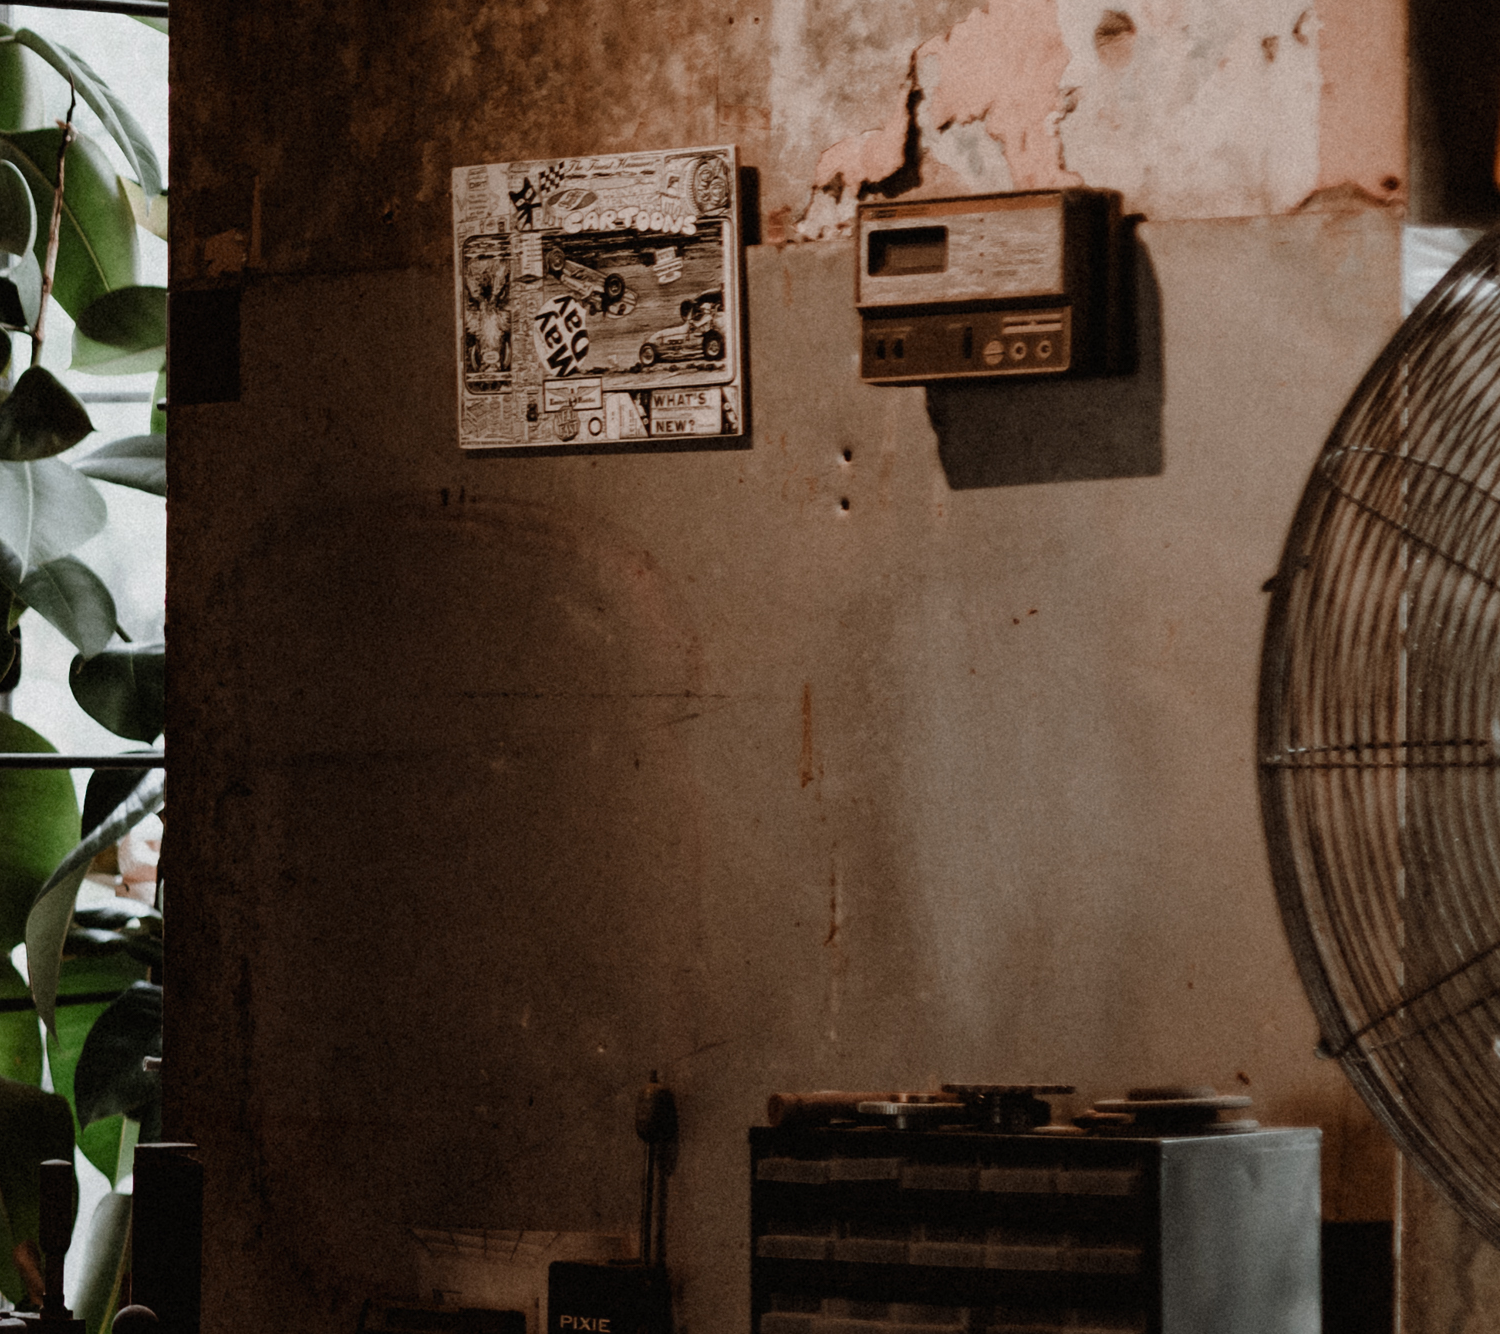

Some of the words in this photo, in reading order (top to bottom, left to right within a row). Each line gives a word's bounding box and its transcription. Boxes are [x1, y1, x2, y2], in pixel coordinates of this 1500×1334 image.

[562, 206, 698, 236] CARTOONS
[653, 392, 707, 409] WHAT'S
[655, 419, 696, 434] NEW?
[560, 1314, 611, 1334] PIXIE
